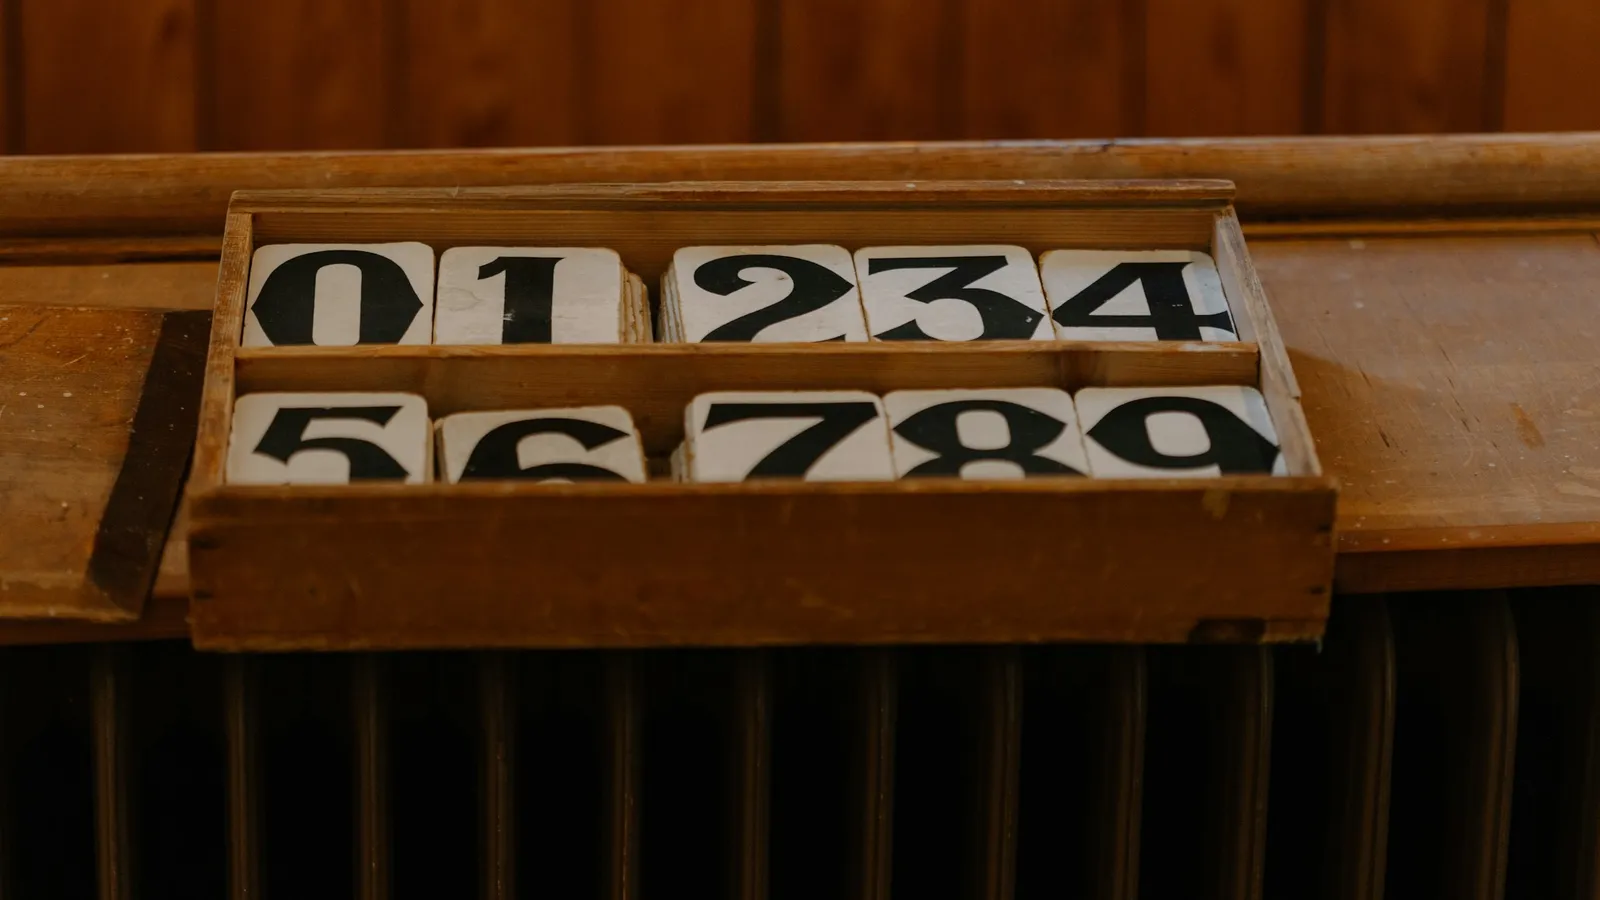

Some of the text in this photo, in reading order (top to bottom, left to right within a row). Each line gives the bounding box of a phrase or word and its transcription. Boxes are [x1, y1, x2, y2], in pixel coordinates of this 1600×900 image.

[251, 250, 1235, 346] 0 1 2 3 4
[253, 406, 410, 484] 5
[702, 402, 879, 480] 7
[893, 400, 1088, 477] 8
[1086, 396, 1281, 476] 9
